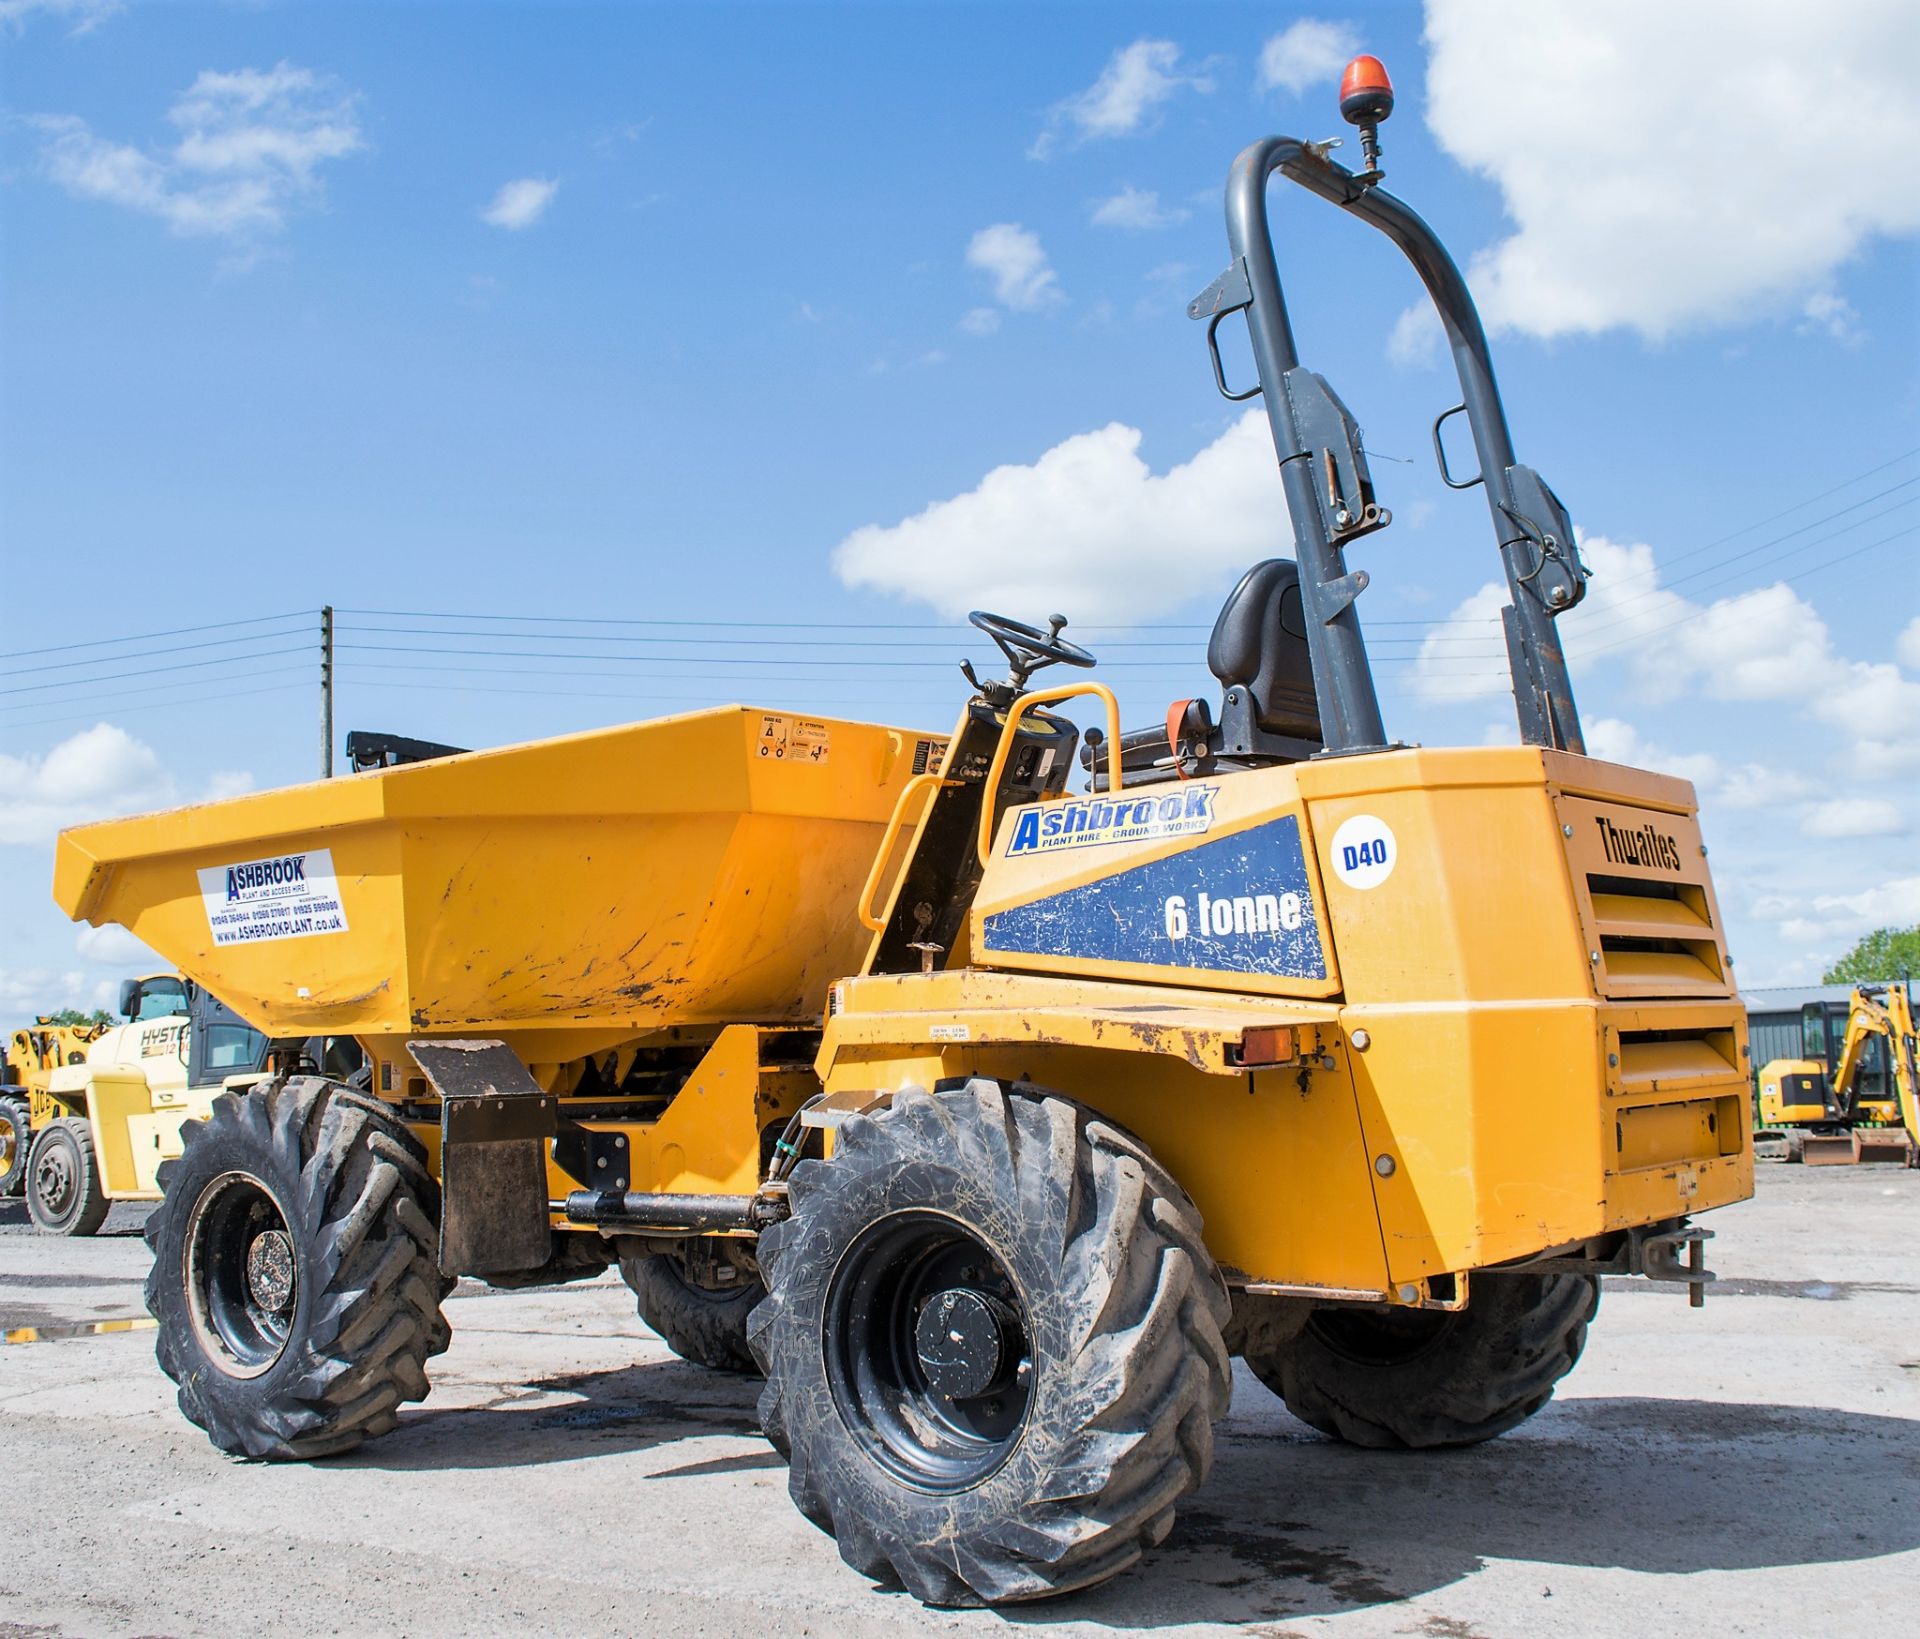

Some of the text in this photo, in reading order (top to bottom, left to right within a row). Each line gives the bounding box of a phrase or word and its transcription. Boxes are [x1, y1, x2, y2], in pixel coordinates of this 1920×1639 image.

[1012, 787, 1208, 851] Ashbrook
[1042, 835, 1072, 848] PLANT
[1076, 832, 1101, 844] HIRE
[1112, 825, 1159, 839] GROUND
[1162, 819, 1206, 833] WORKS
[1343, 838, 1387, 871] D40
[1595, 816, 1680, 871] Thwaites
[228, 858, 305, 901] ASHBROOK
[242, 883, 305, 900] PLANT AND ACCESS HIRE
[1165, 892, 1301, 940] 6 tonne
[34, 1089, 50, 1117] JCB
